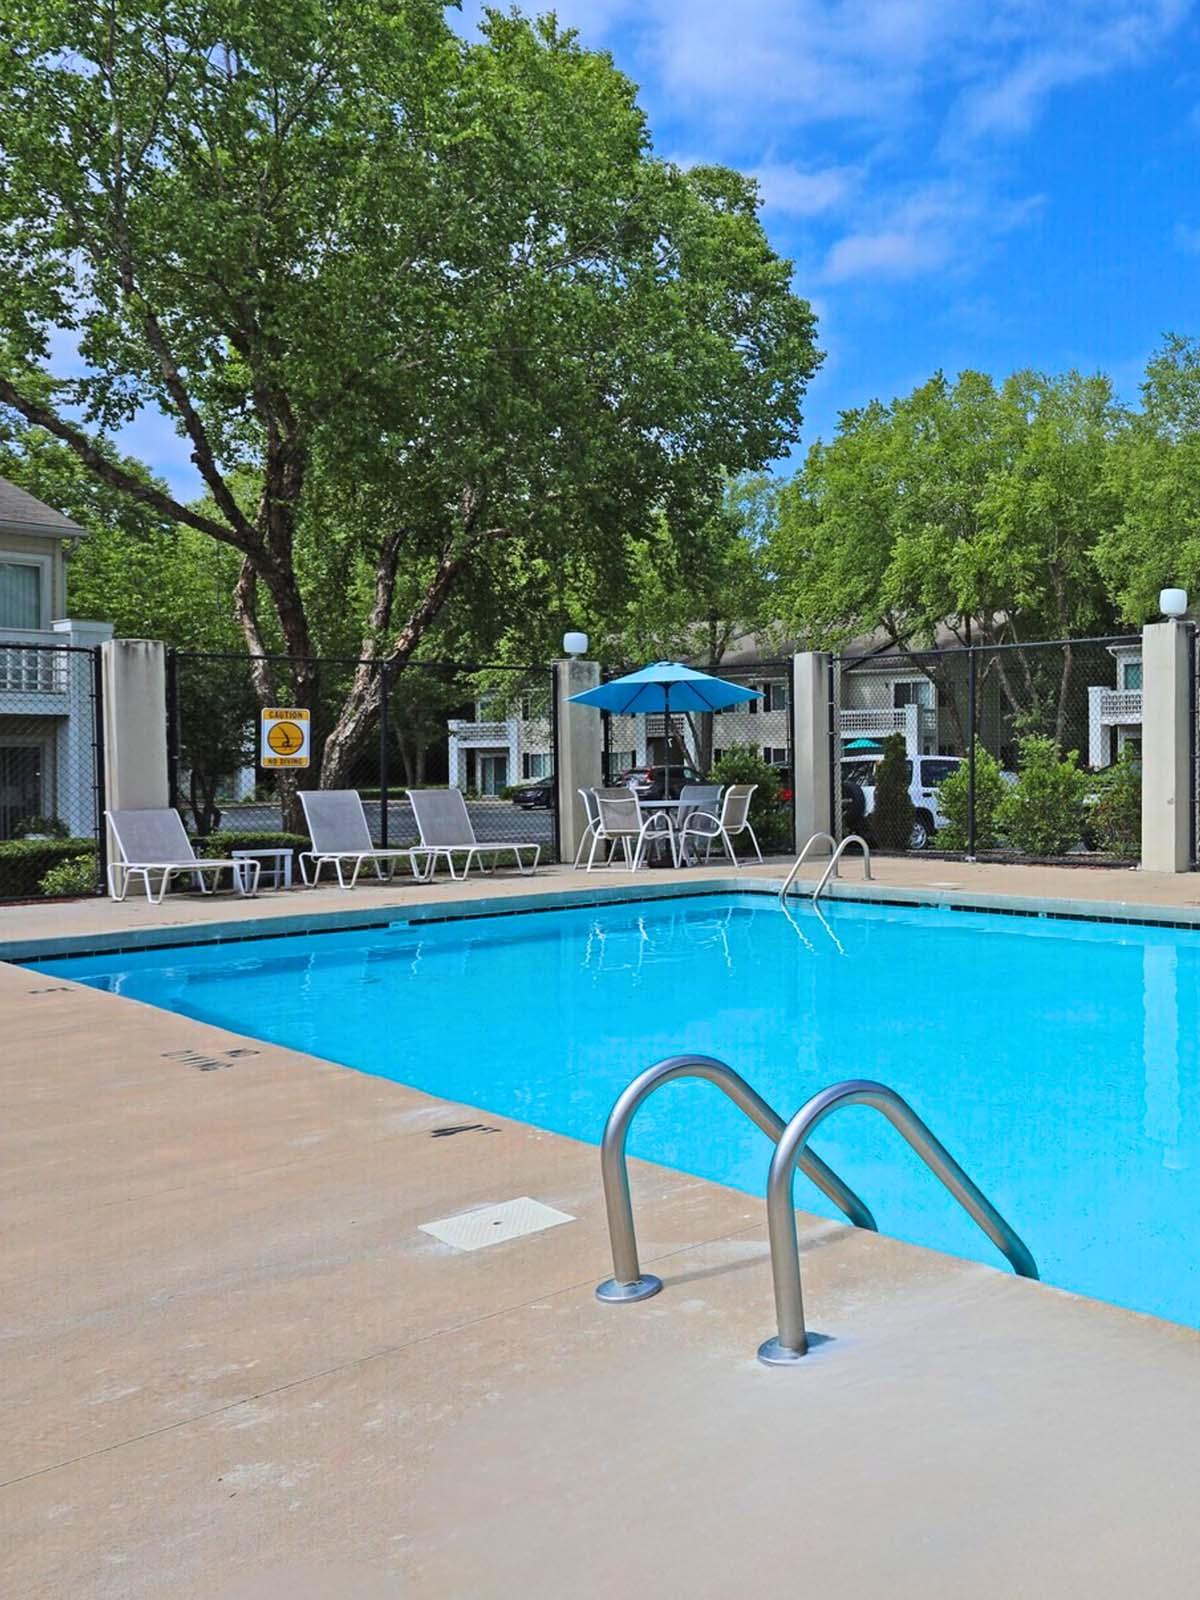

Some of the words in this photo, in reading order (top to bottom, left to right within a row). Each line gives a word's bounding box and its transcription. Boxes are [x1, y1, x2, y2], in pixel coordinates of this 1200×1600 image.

[268, 710, 303, 719] CAUTION
[267, 757, 277, 766] NO
[279, 757, 303, 766] DIVING
